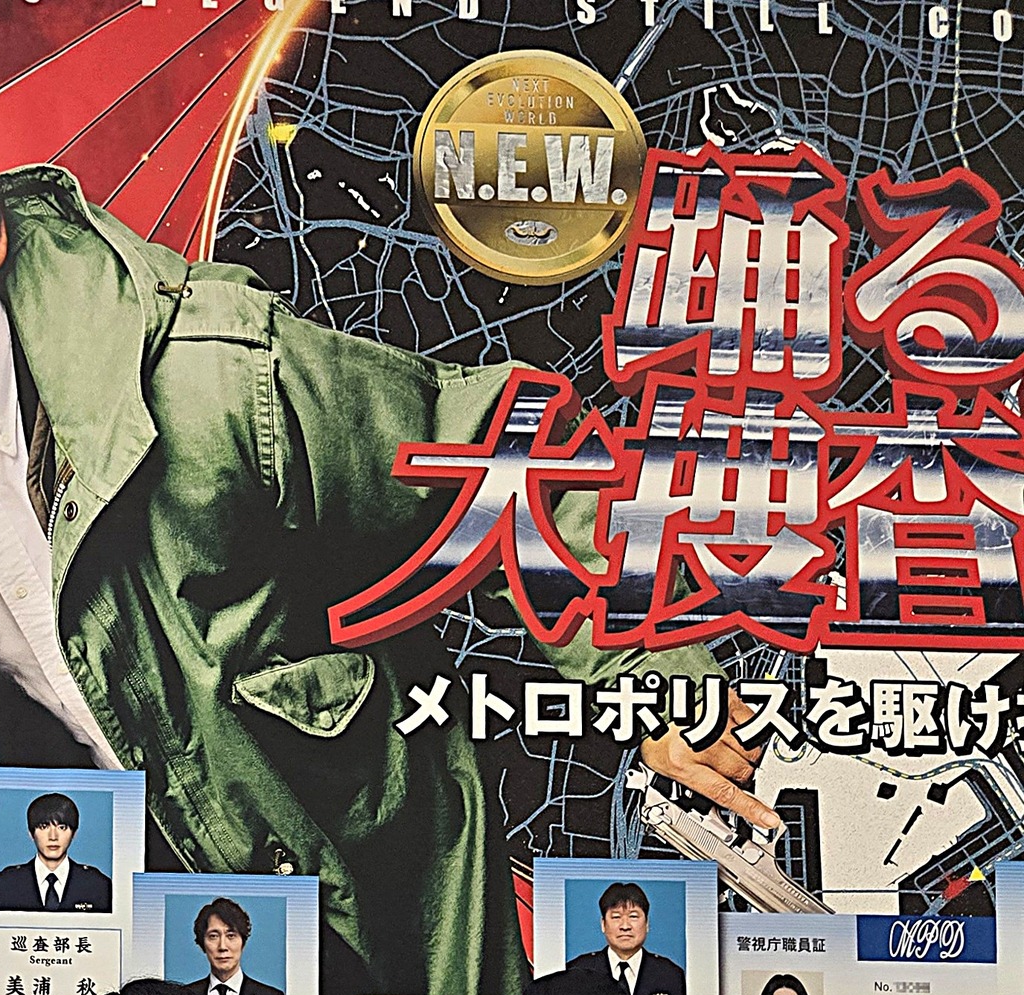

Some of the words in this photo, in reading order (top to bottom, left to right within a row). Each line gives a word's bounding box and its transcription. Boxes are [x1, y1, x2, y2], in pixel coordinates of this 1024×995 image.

[512, 78, 550, 92] NEXT
[487, 92, 575, 109] EVOLUTION
[504, 109, 557, 126] WORLD
[434, 130, 627, 205] N.E.W.
[606, 145, 1024, 392] 踊る
[396, 671, 1024, 750] メトロポリスを駆け
[10, 936, 93, 953] 巡査部長
[737, 937, 826, 953] 警視庁職員証
[29, 955, 73, 966] Sergeant
[874, 982, 893, 992] No.
